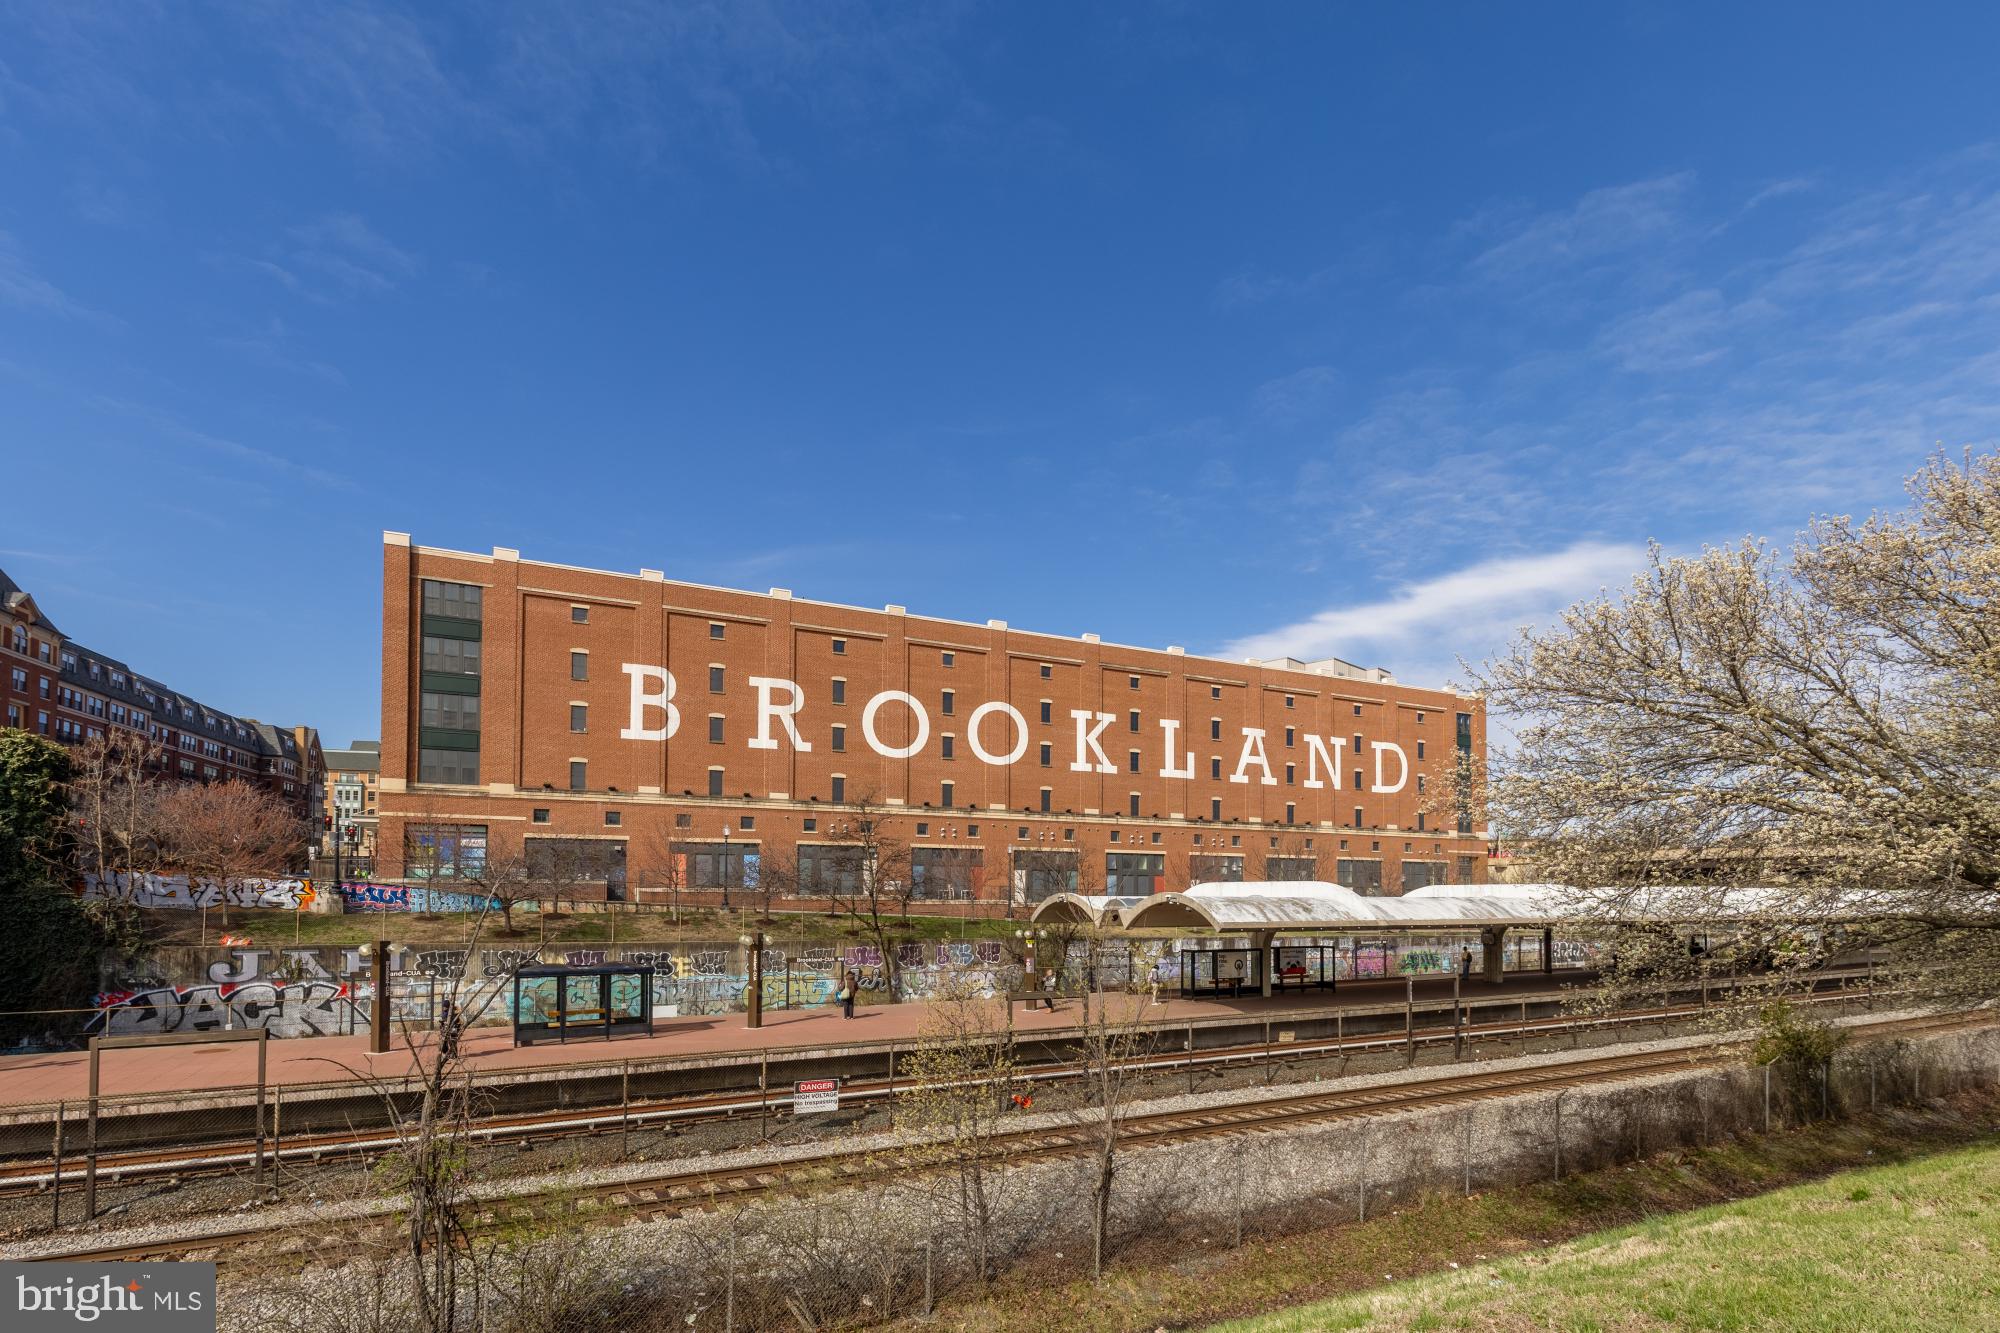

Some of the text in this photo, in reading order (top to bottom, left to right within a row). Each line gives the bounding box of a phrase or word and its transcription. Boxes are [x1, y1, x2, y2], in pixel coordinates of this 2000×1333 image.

[620, 662, 1409, 794] BROOKLAND
[365, 970, 422, 978] Band-CUA
[800, 1082, 833, 1091] DANGER
